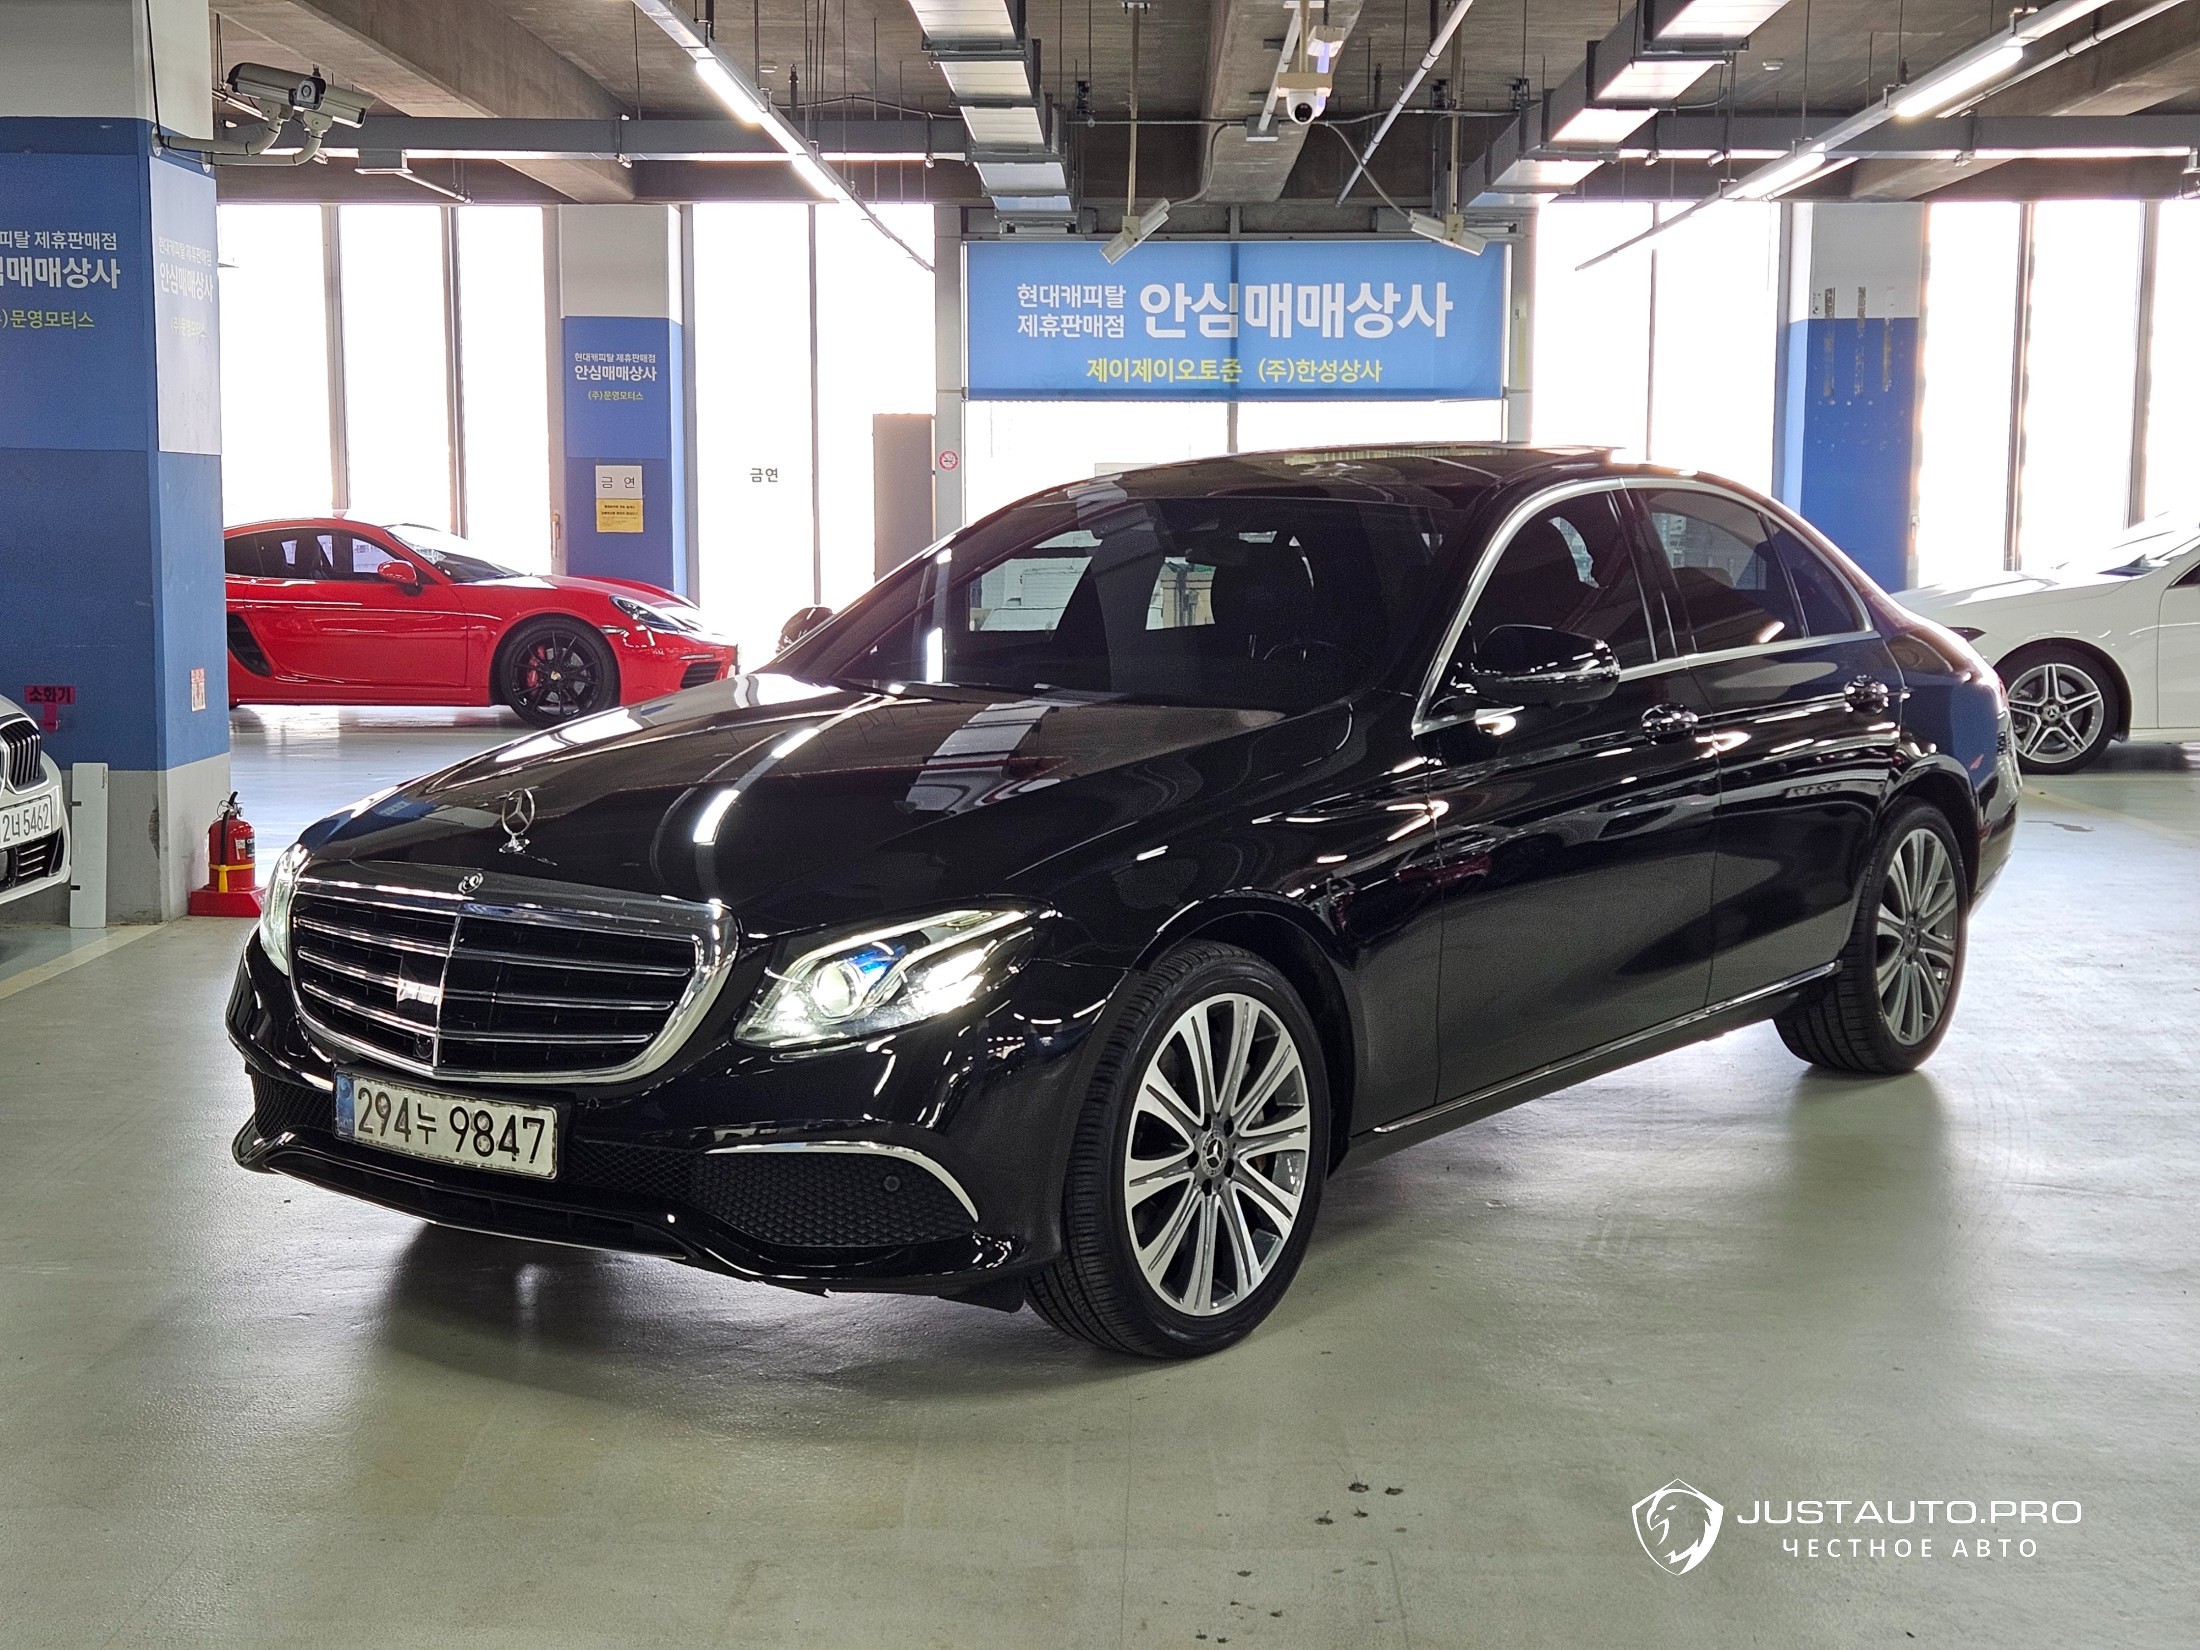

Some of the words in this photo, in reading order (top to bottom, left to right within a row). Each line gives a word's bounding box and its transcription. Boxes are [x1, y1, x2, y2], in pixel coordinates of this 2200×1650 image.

[34, 230, 117, 251] 제휴판매점
[160, 262, 214, 303] 안심매매상사
[1017, 283, 1127, 309] 현대캐피탈
[0, 308, 95, 329] )문영모터스
[1139, 282, 1454, 338] 안심매매상사
[1017, 313, 1125, 338] 제휴판매점
[574, 352, 615, 363] 현대캐피탈
[616, 353, 656, 364] 제휴판매점
[574, 365, 658, 382] 안심매매상사
[1086, 357, 1244, 383] 제이제이오토준
[1258, 357, 1383, 383] (주)한성상사
[588, 390, 645, 401] (주)문영모터스
[750, 467, 778, 483] 금연
[29, 686, 71, 704] 소화기
[23, 803, 50, 836] 5462
[357, 1087, 437, 1144] 294누
[450, 1106, 545, 1163] 9847
